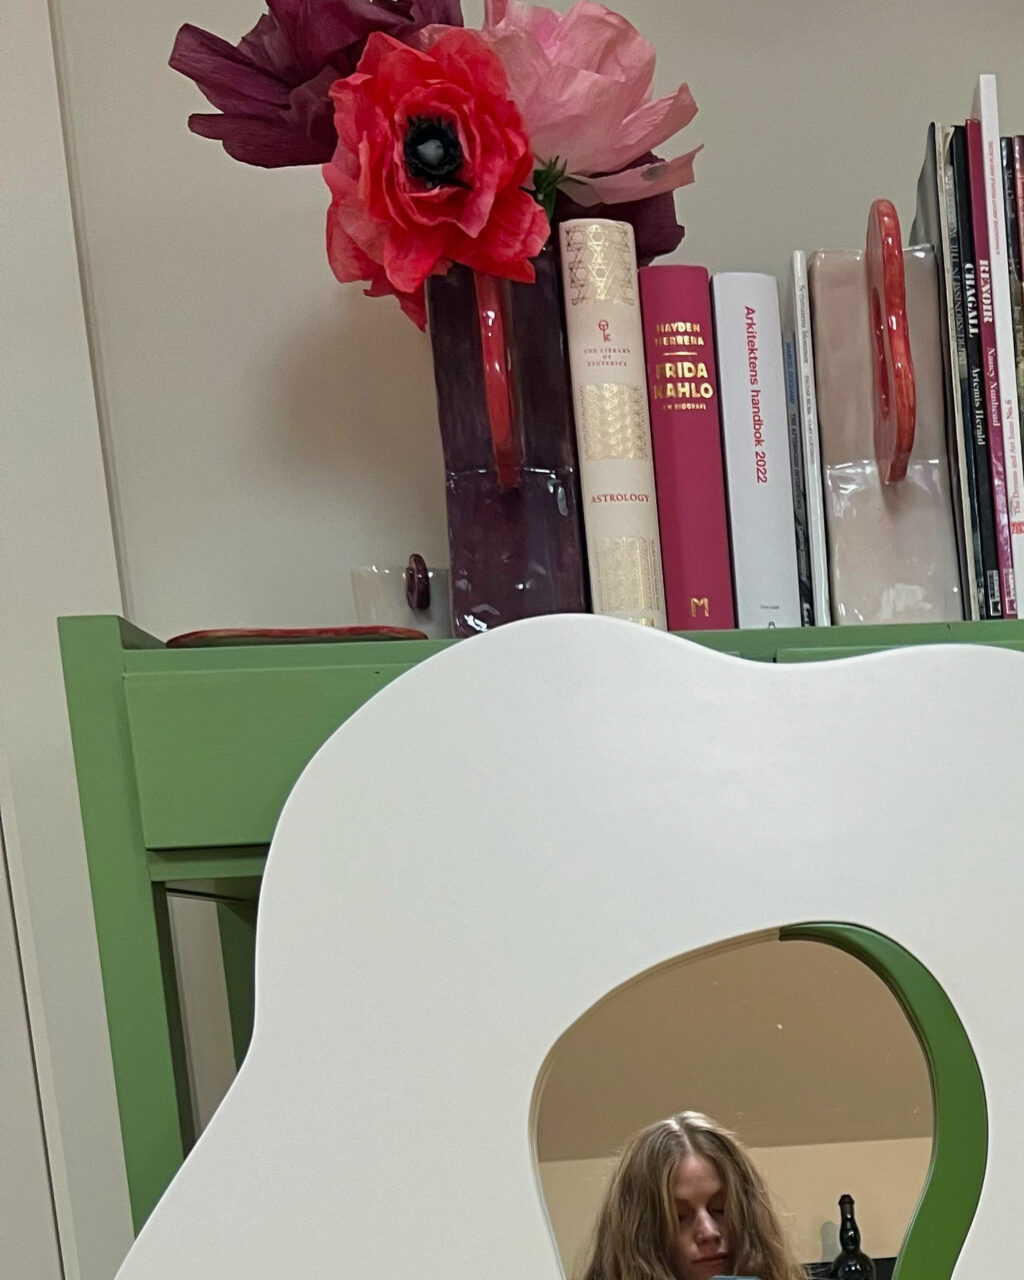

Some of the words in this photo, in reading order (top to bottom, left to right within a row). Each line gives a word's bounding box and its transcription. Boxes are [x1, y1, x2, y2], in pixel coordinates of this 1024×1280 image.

[964, 263, 979, 338] CHAGALL
[656, 321, 701, 333] HAYDEN
[979, 259, 993, 323] RENOIR
[986, 347, 996, 379] Nancy
[654, 335, 704, 346] HERRERA
[744, 305, 760, 386] Arkitektens
[655, 361, 709, 380] FRIDA
[971, 366, 982, 407] Artemis
[653, 382, 714, 400] KAHLO
[750, 389, 765, 447] handbok
[975, 410, 986, 446] Herald
[755, 450, 768, 484] 2022
[591, 493, 650, 504] ASTROLOGY
[690, 598, 710, 617] M
